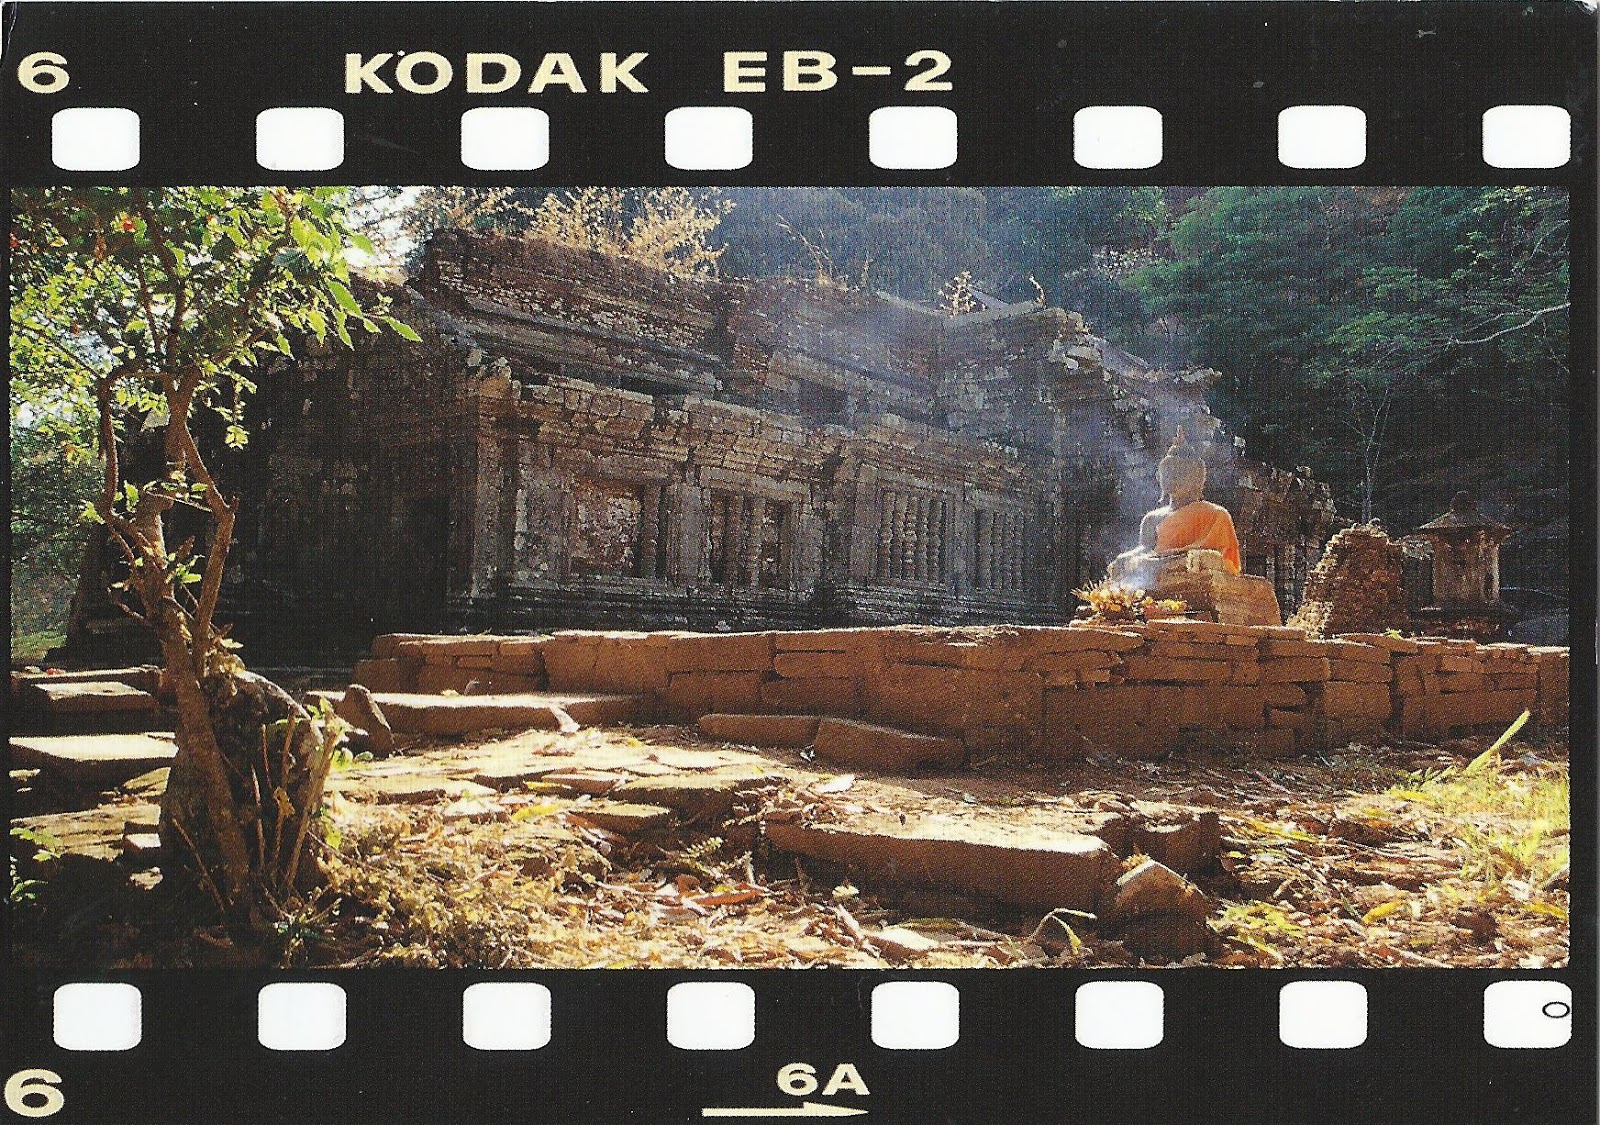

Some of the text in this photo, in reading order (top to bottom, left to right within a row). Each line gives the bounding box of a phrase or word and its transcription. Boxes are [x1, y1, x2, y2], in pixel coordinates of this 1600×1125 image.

[17, 50, 71, 95] 6
[344, 49, 954, 95] KODAK EB-2
[3, 1067, 66, 1118] 6
[777, 1061, 871, 1097] 6A
